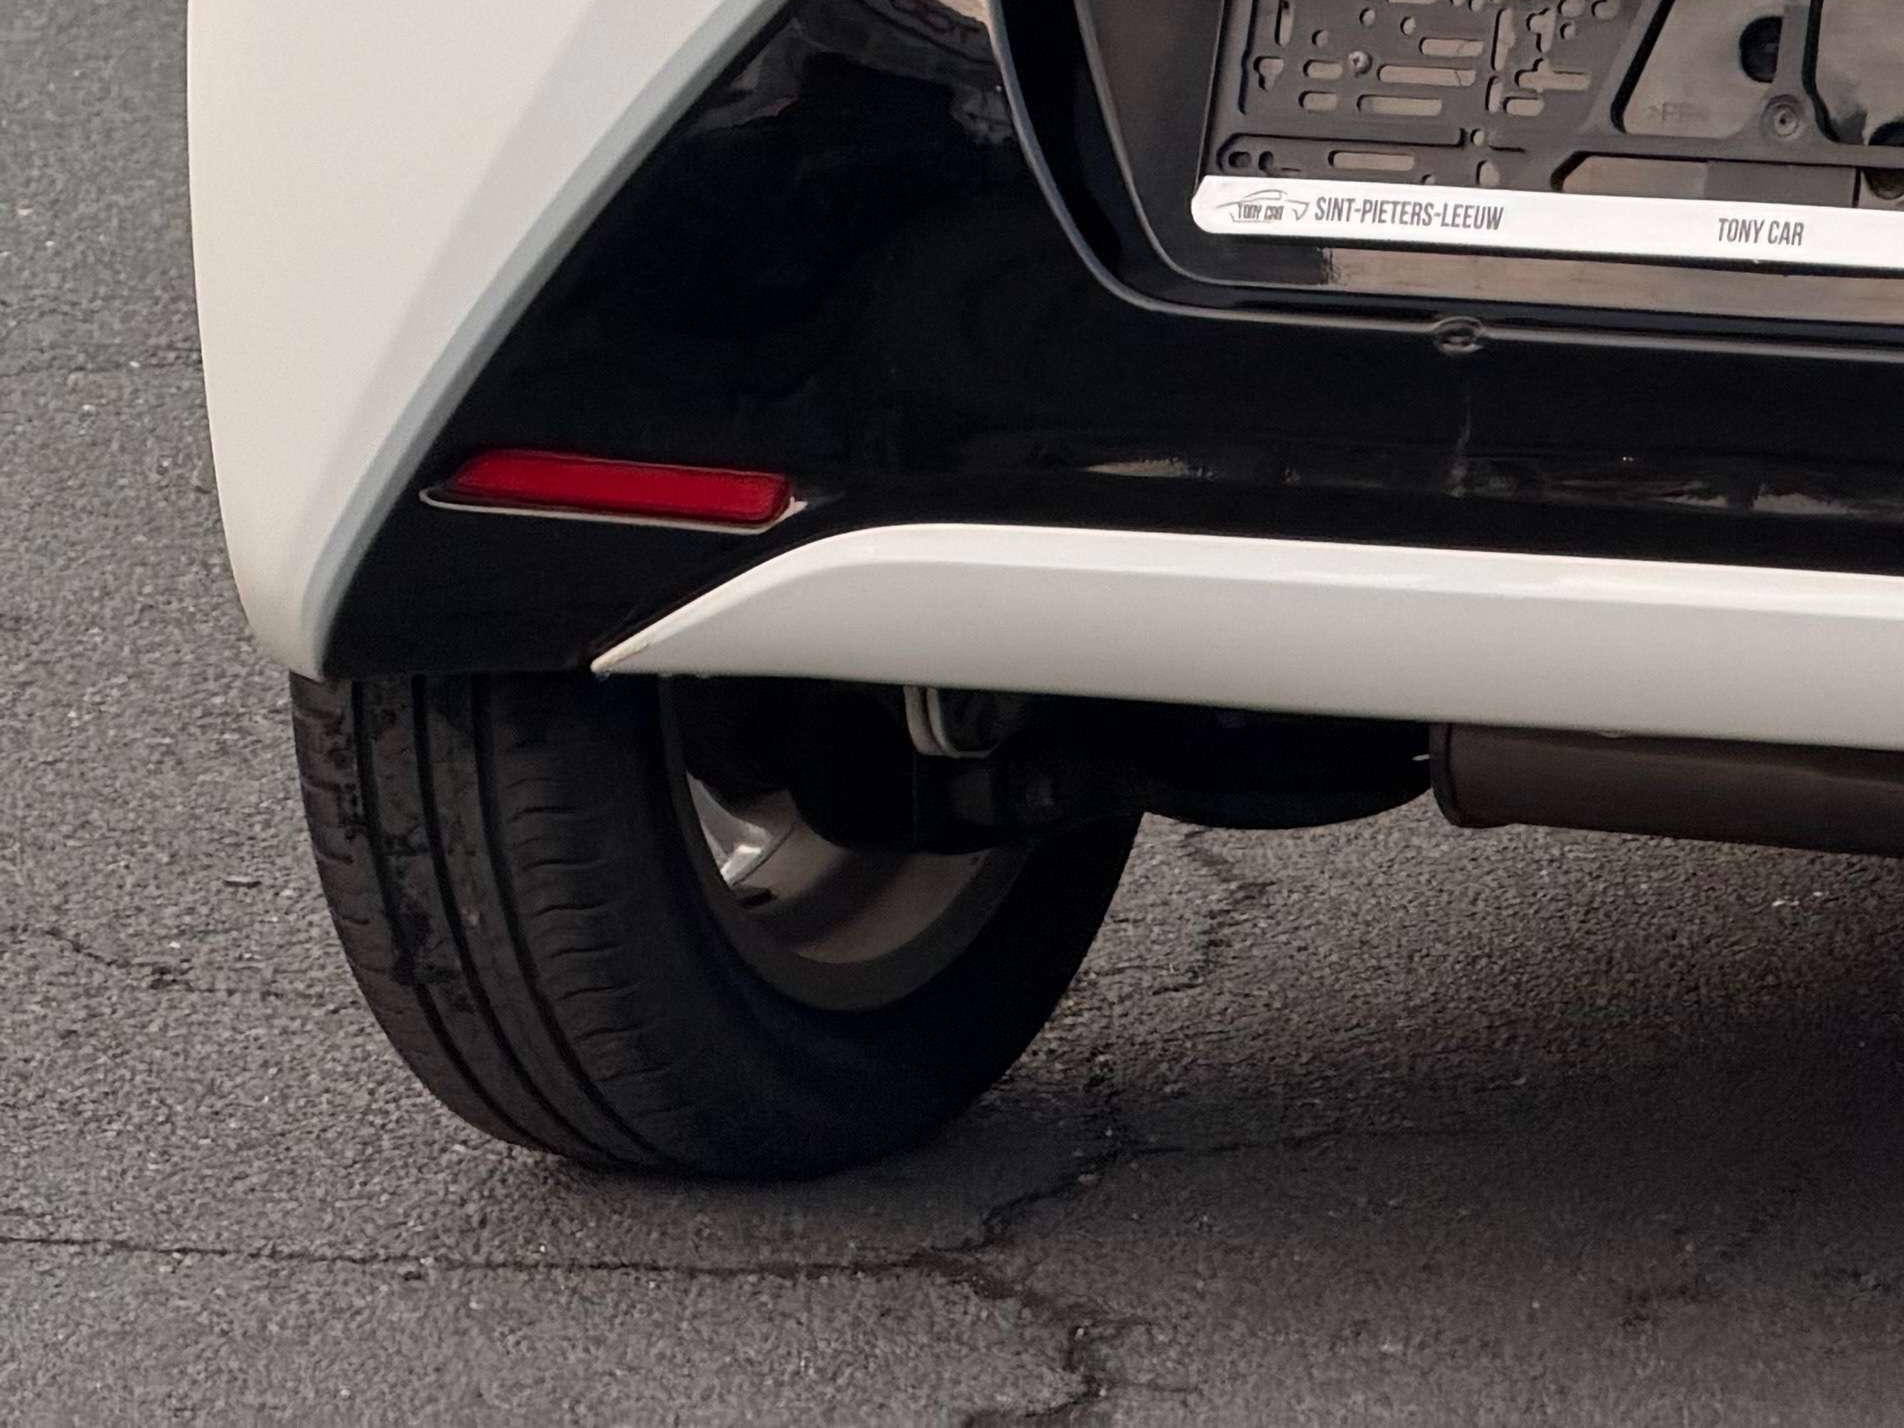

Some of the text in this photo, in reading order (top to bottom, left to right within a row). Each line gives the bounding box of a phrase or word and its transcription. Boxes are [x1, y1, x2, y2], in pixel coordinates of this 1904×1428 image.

[1314, 196, 1504, 230] SINT-PIETERS-LEEUW
[1718, 217, 1805, 246] TONY CAR
